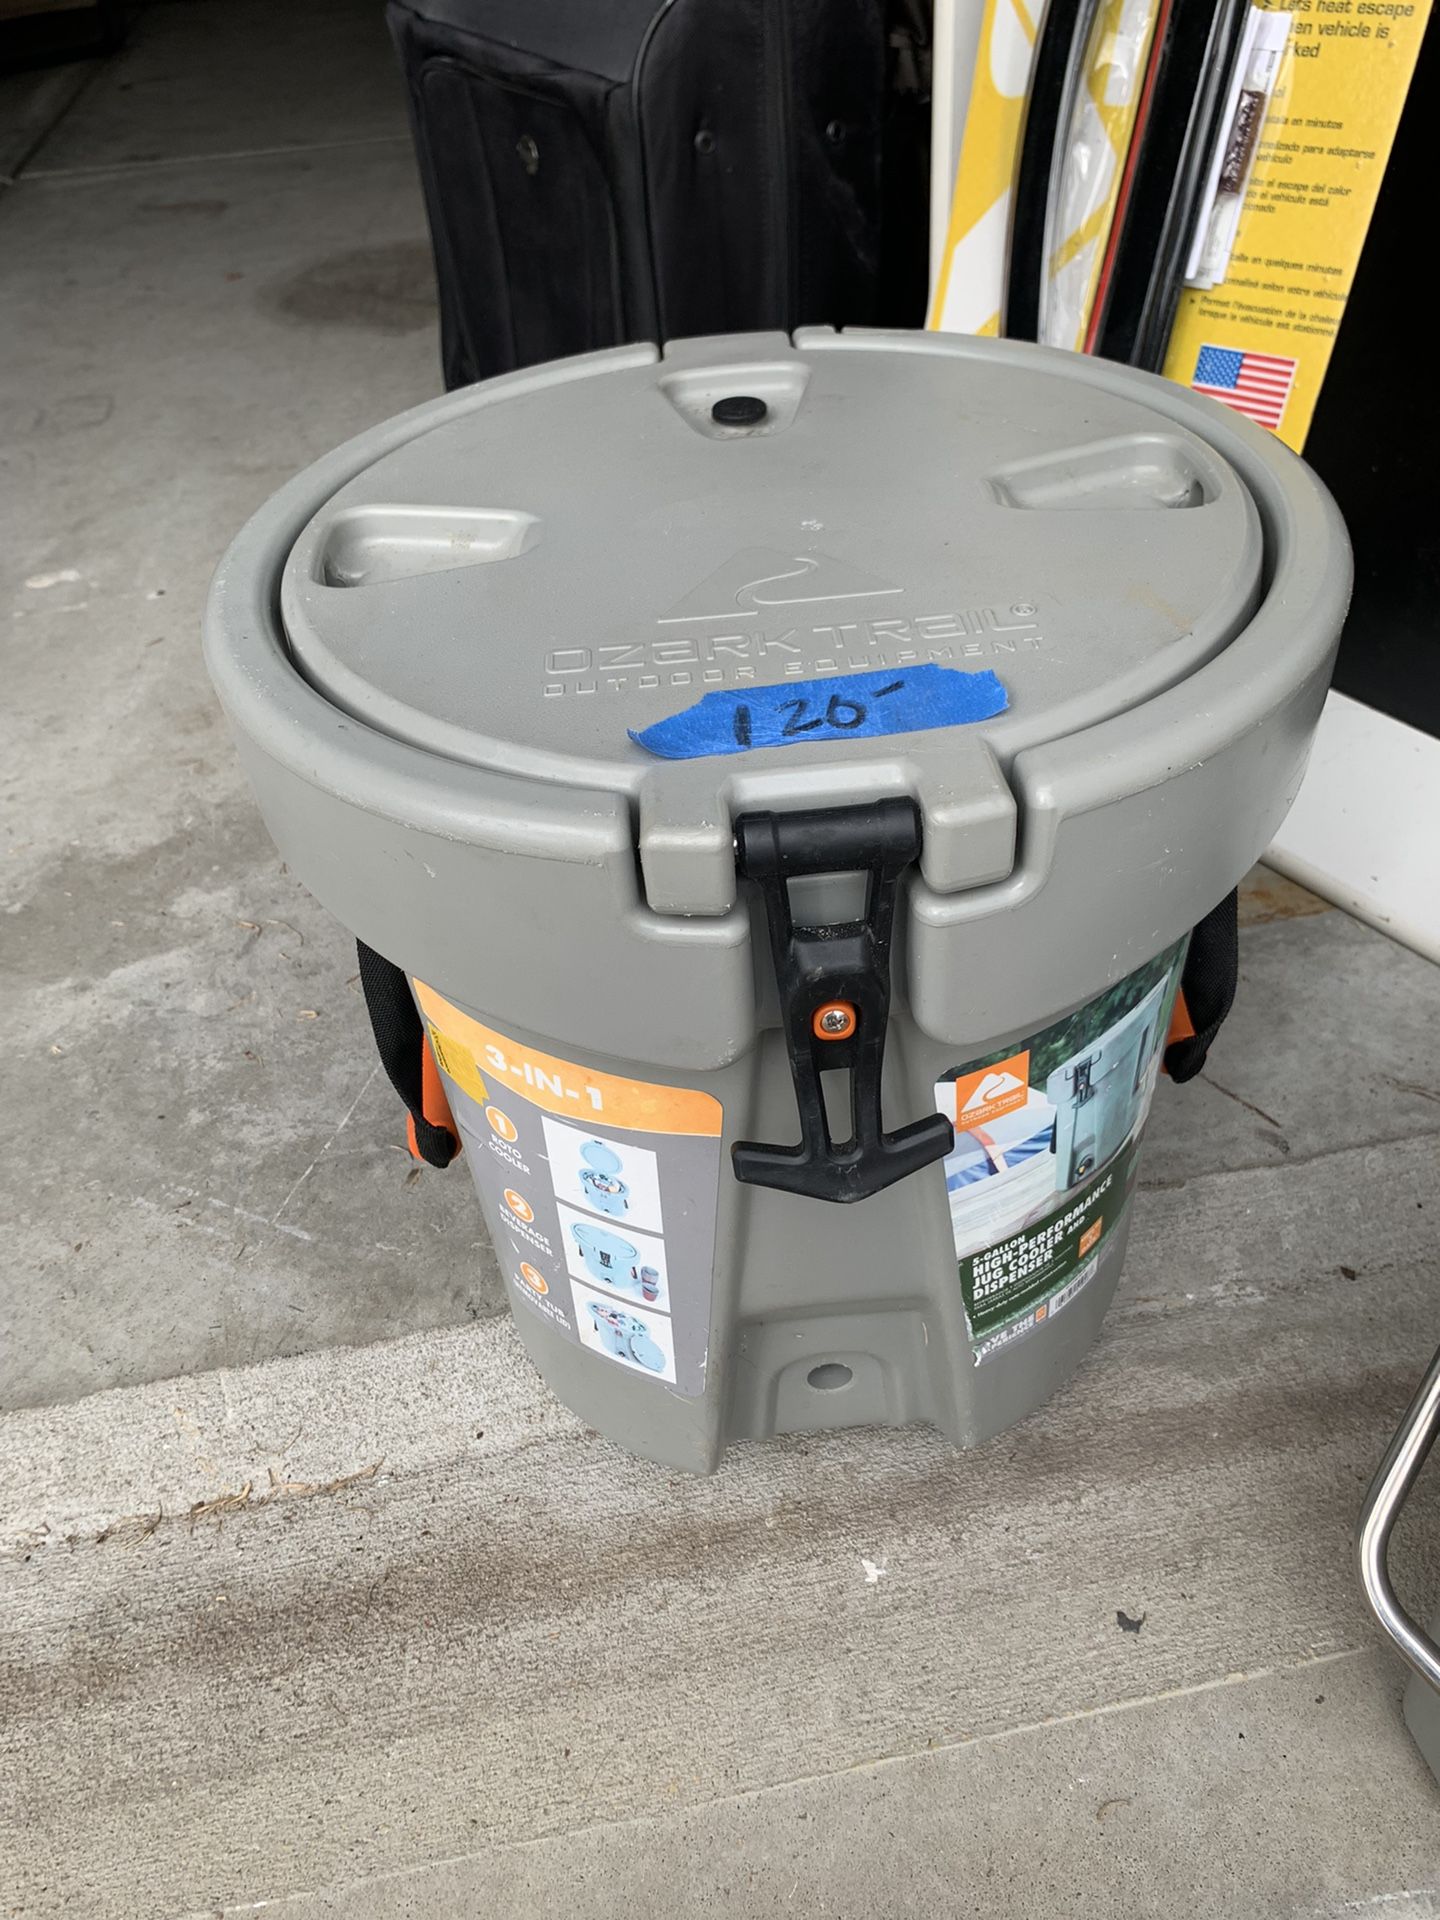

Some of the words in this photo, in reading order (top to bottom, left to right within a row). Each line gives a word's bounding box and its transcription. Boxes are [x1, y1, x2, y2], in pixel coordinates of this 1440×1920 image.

[1316, 0, 1351, 13] heat
[1356, 1, 1415, 20] escape
[1318, 20, 1371, 39] vehicle
[1375, 22, 1390, 39] is
[1305, 117, 1343, 129] minutos
[1302, 145, 1324, 155] para
[1327, 145, 1375, 159] adaptarse
[1277, 181, 1308, 193] escape
[1306, 262, 1343, 276] minutes
[544, 629, 801, 675] OZARK
[543, 666, 756, 697] OUTDOOR
[782, 636, 1044, 675] EQUIPMENT
[484, 1044, 604, 1112] 3-IN-1
[494, 1112, 508, 1135] 1
[488, 1141, 532, 1176] COOLER
[490, 1133, 523, 1160] ROTO
[509, 1193, 529, 1219] 2
[972, 1174, 1113, 1278] HIGH-PERFORMANCE
[972, 1234, 1026, 1267] 5-GALLON
[972, 1267, 1003, 1290] JUG
[1008, 1231, 1064, 1272] COOLER
[1067, 1215, 1086, 1235] AND
[972, 1249, 1054, 1301] DISPENSER
